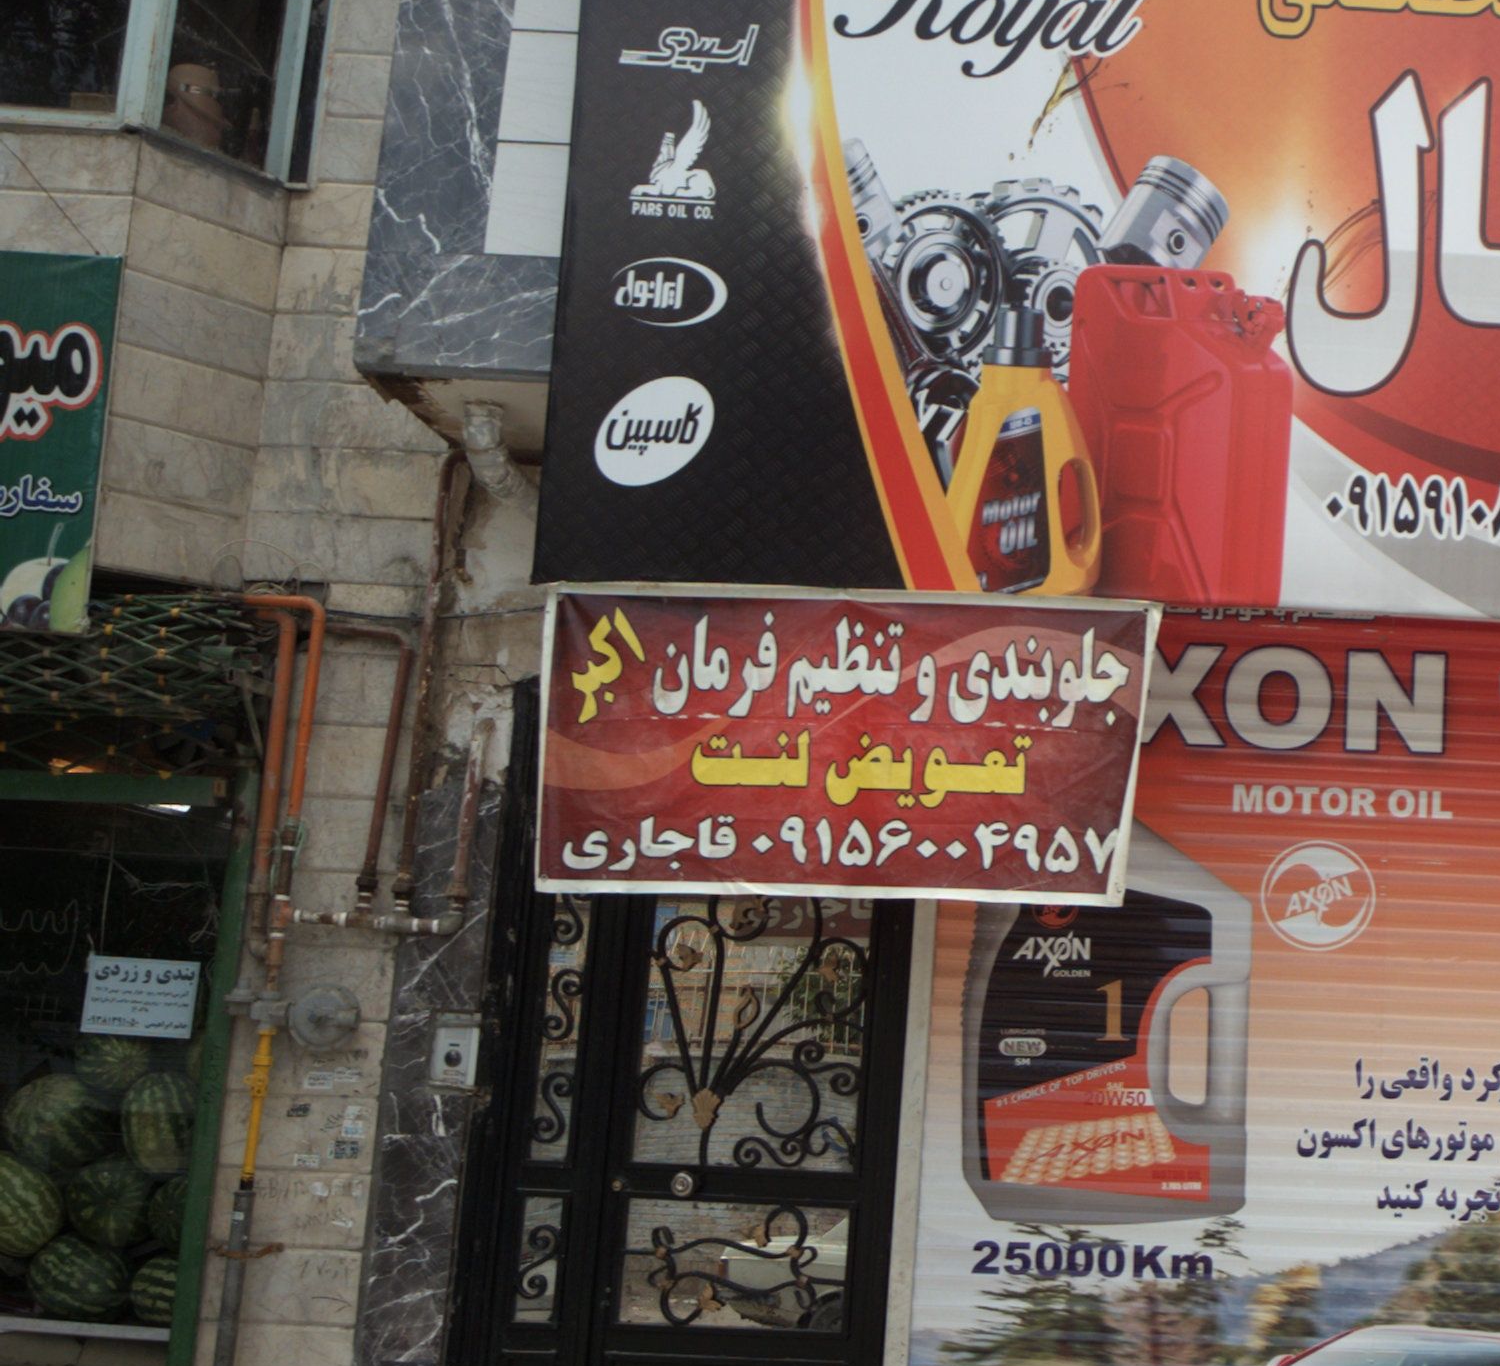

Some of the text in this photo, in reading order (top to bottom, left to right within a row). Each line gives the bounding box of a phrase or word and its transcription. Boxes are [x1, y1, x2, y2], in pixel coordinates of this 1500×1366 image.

[631, 202, 714, 220] PARS OIL CO.
[605, 400, 702, 456] کاسپین
[0, 475, 82, 514] سفار
[981, 490, 1042, 526] Motor
[998, 516, 1038, 556] OIL
[653, 611, 779, 719] فرمان
[787, 615, 905, 719] تنظیم
[949, 625, 1131, 727] جلوبندی
[909, 653, 936, 723] و
[1141, 643, 1448, 754] XON
[691, 730, 1034, 808] تعویض لنت
[1232, 785, 1454, 820] MOTOR OIL
[561, 815, 1121, 875] ۰۹۱۵۶۰۰۴۹۵۷ قاجاری
[1053, 969, 1091, 978] GOLDEN
[1096, 980, 1130, 1042] 1
[1004, 1040, 1042, 1053] NEW
[1012, 1086, 1047, 1104] CHOICE
[1065, 1075, 1084, 1087] TOP
[1086, 1062, 1127, 1081] DRIVERS
[1086, 1091, 1147, 1106] 20W50
[1355, 1059, 1374, 1100] را
[1380, 1058, 1453, 1102] واقعی
[1380, 1118, 1495, 1162] موتورهای
[1376, 1179, 1428, 1213] کنید
